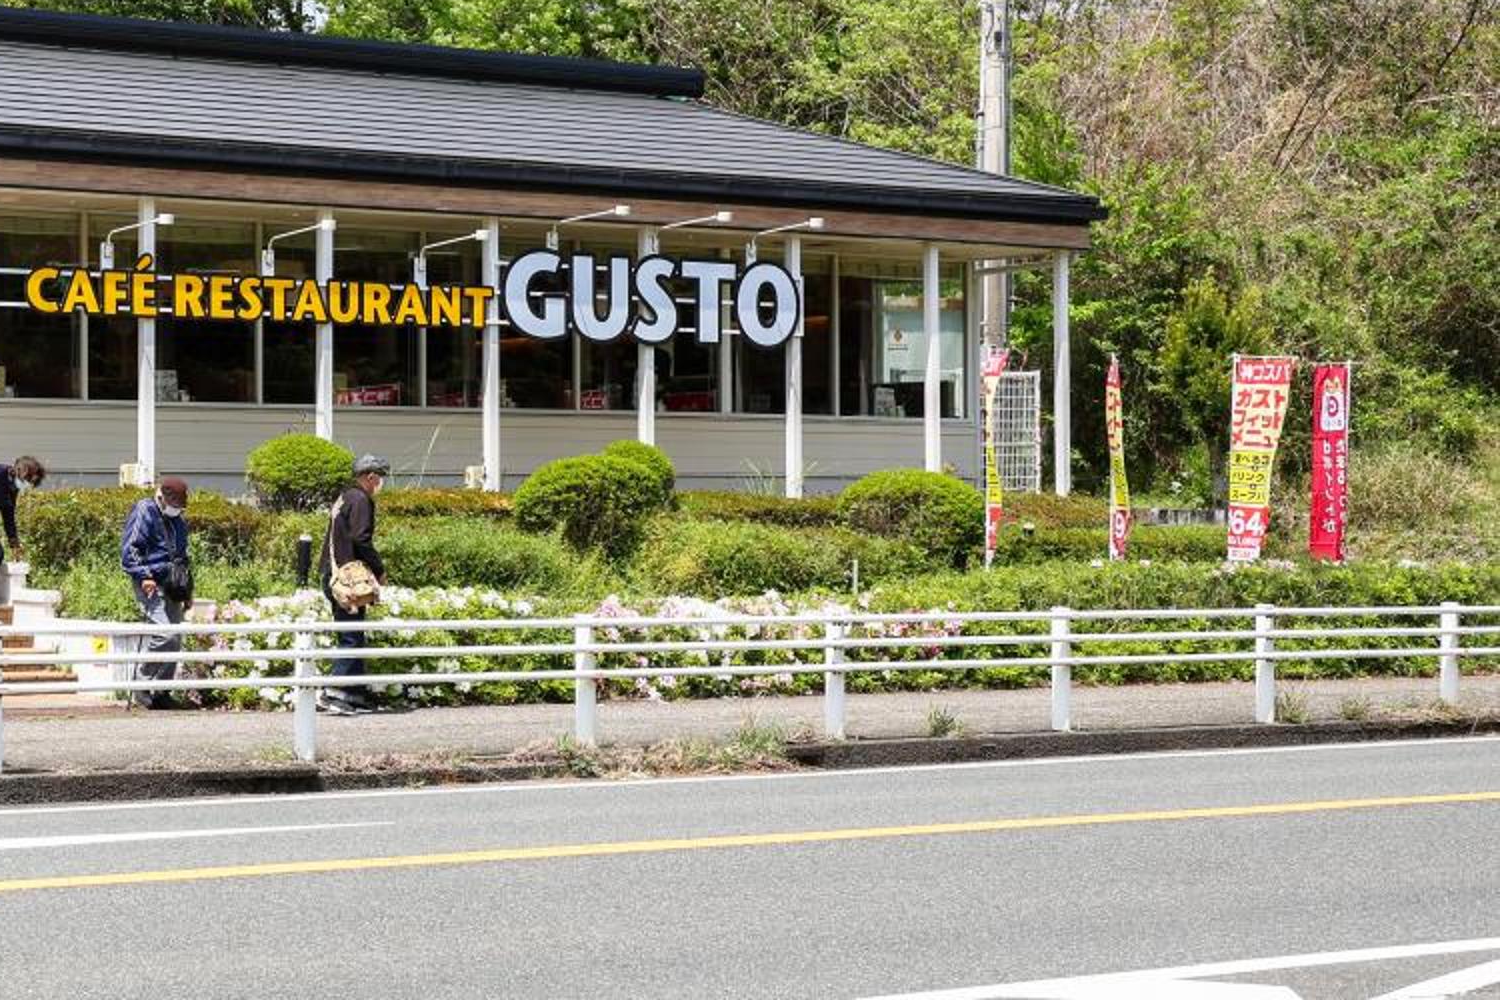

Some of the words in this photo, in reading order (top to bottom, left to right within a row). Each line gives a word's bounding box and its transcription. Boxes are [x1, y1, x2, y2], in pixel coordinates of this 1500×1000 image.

[26, 253, 158, 317] CAFÉ
[175, 272, 493, 328] RESTAURANT
[503, 249, 800, 347] GUSTO
[1235, 389, 1285, 409] ガスト
[1233, 410, 1281, 429] フィット
